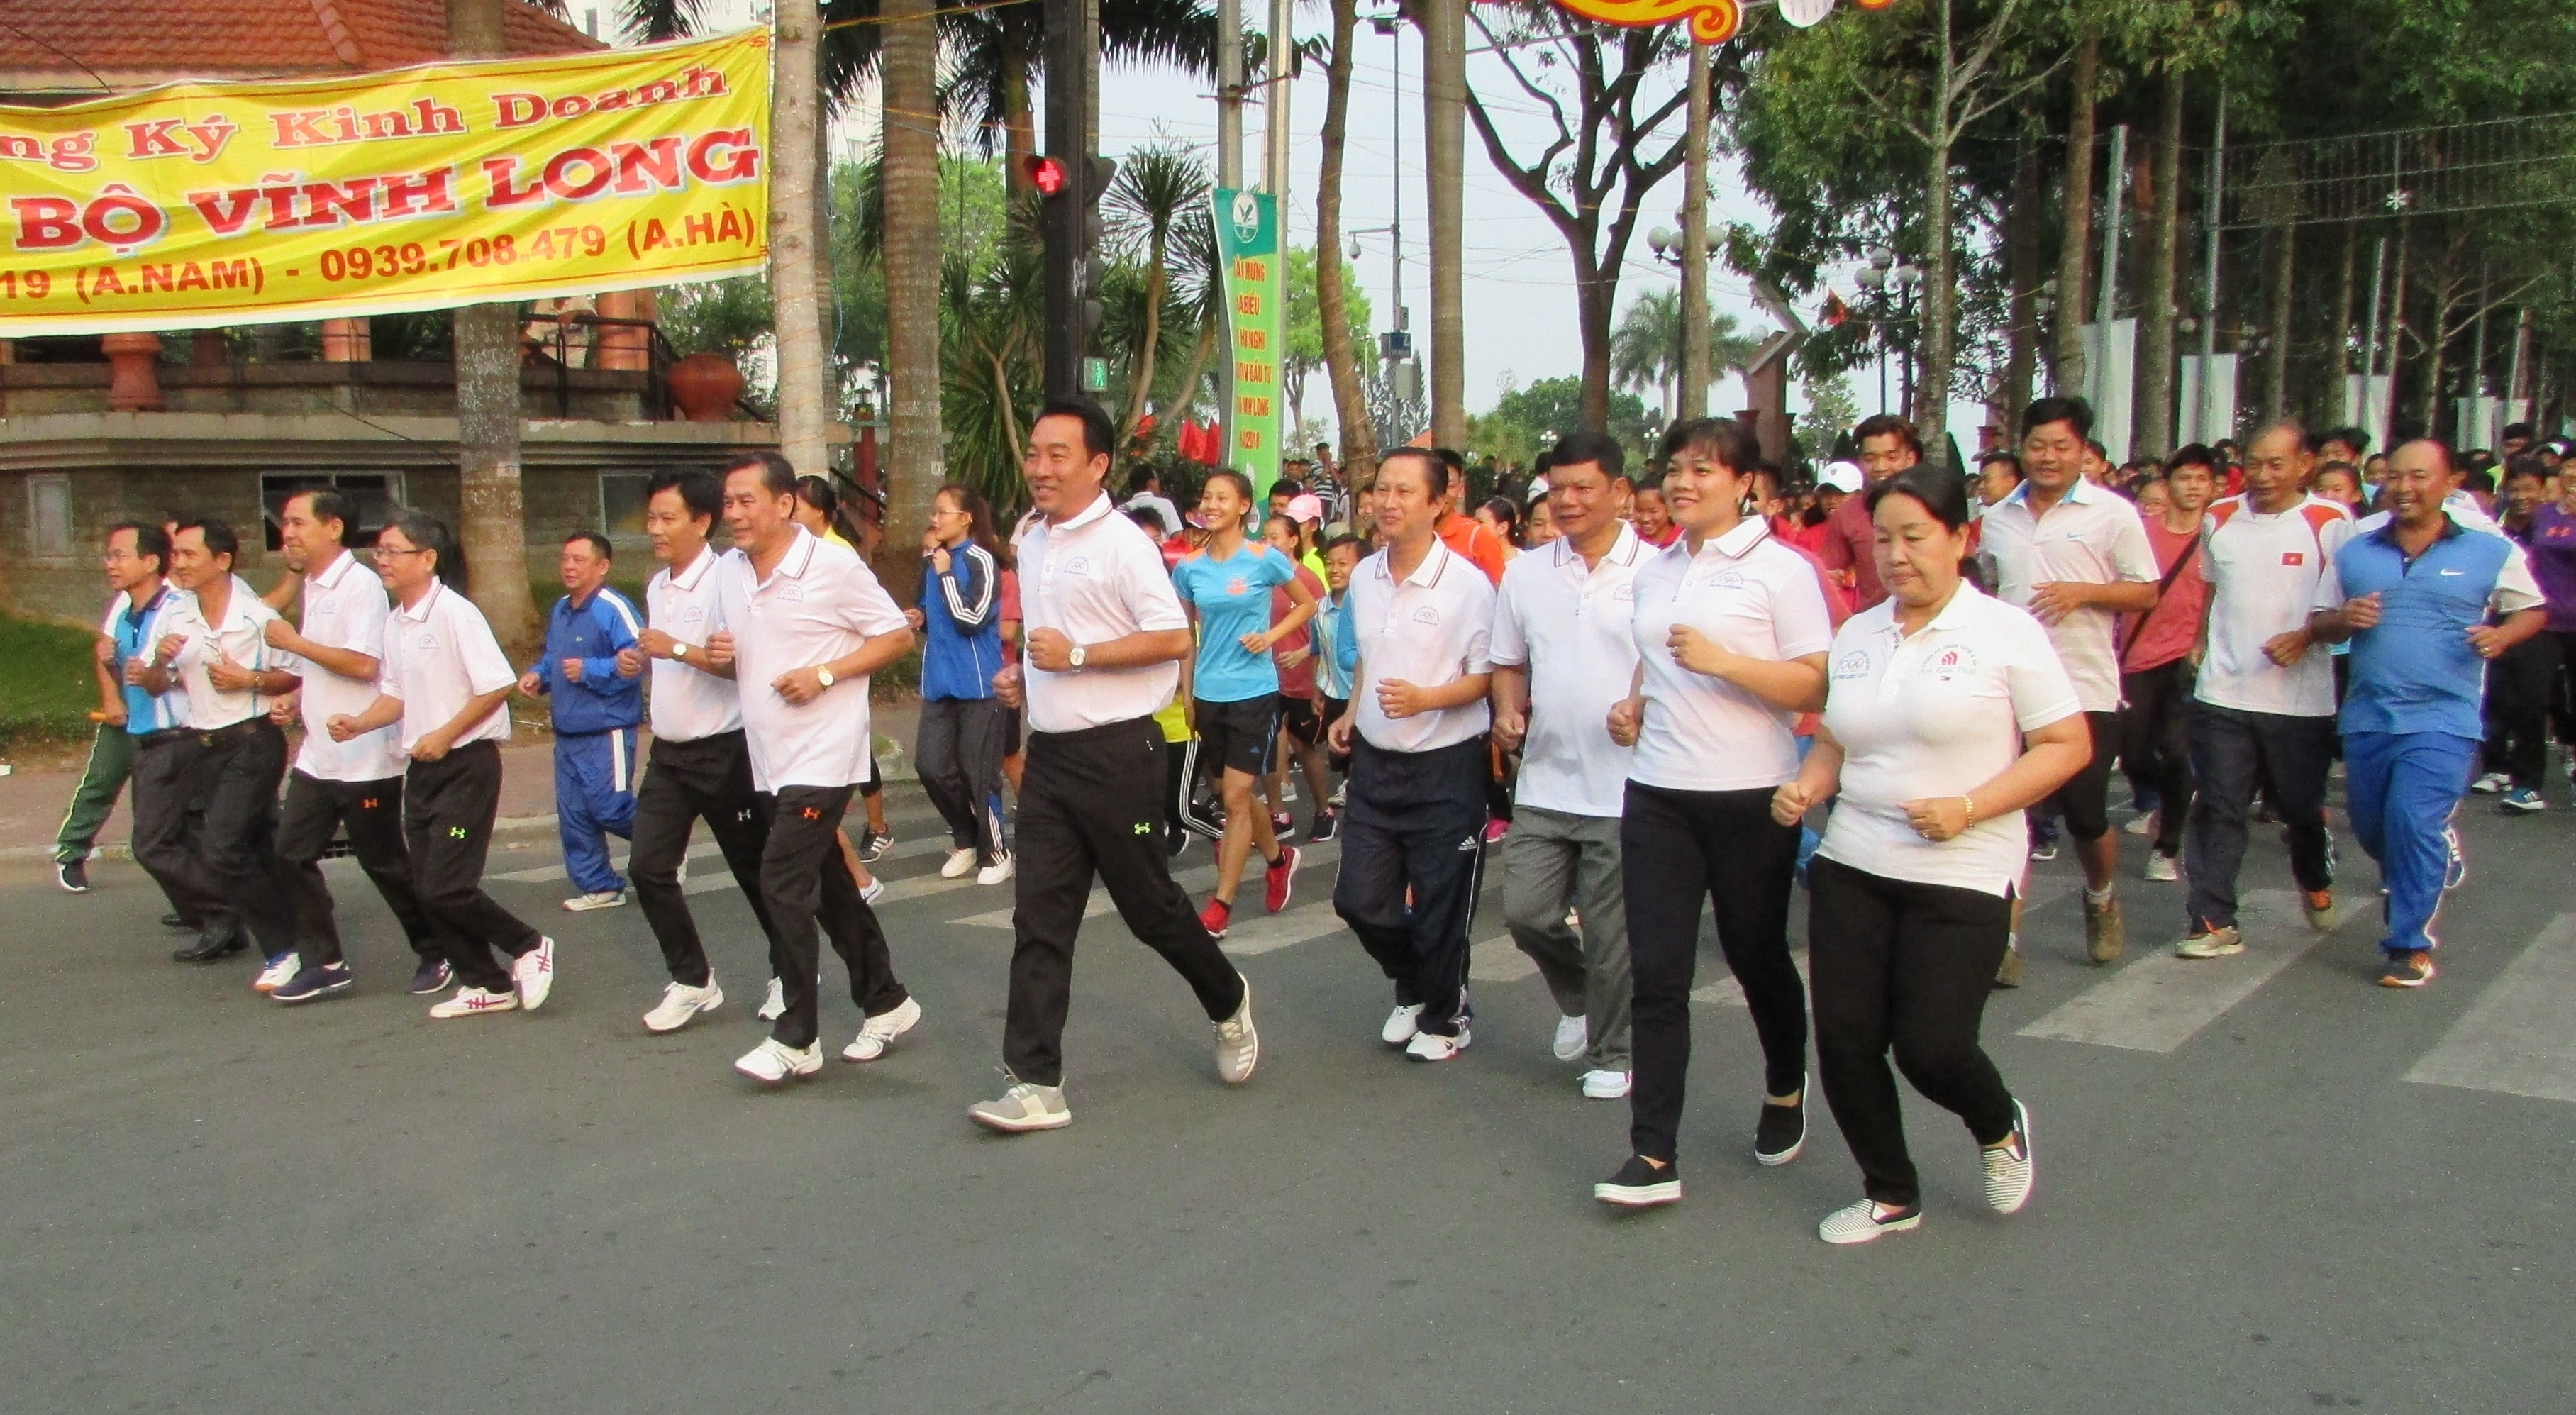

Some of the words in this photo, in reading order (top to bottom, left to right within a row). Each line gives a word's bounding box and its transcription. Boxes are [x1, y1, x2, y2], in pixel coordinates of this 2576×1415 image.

[125, 116, 235, 162] Ký
[268, 96, 465, 147] Kinh
[489, 66, 728, 128] Doanh
[11, 184, 163, 253] BỘ
[189, 167, 455, 234] VĨNH
[482, 128, 759, 207] LONG
[76, 258, 264, 304] (A.NAM)
[321, 225, 606, 282] 0939.708.479
[627, 201, 755, 260] (A.HÀ)
